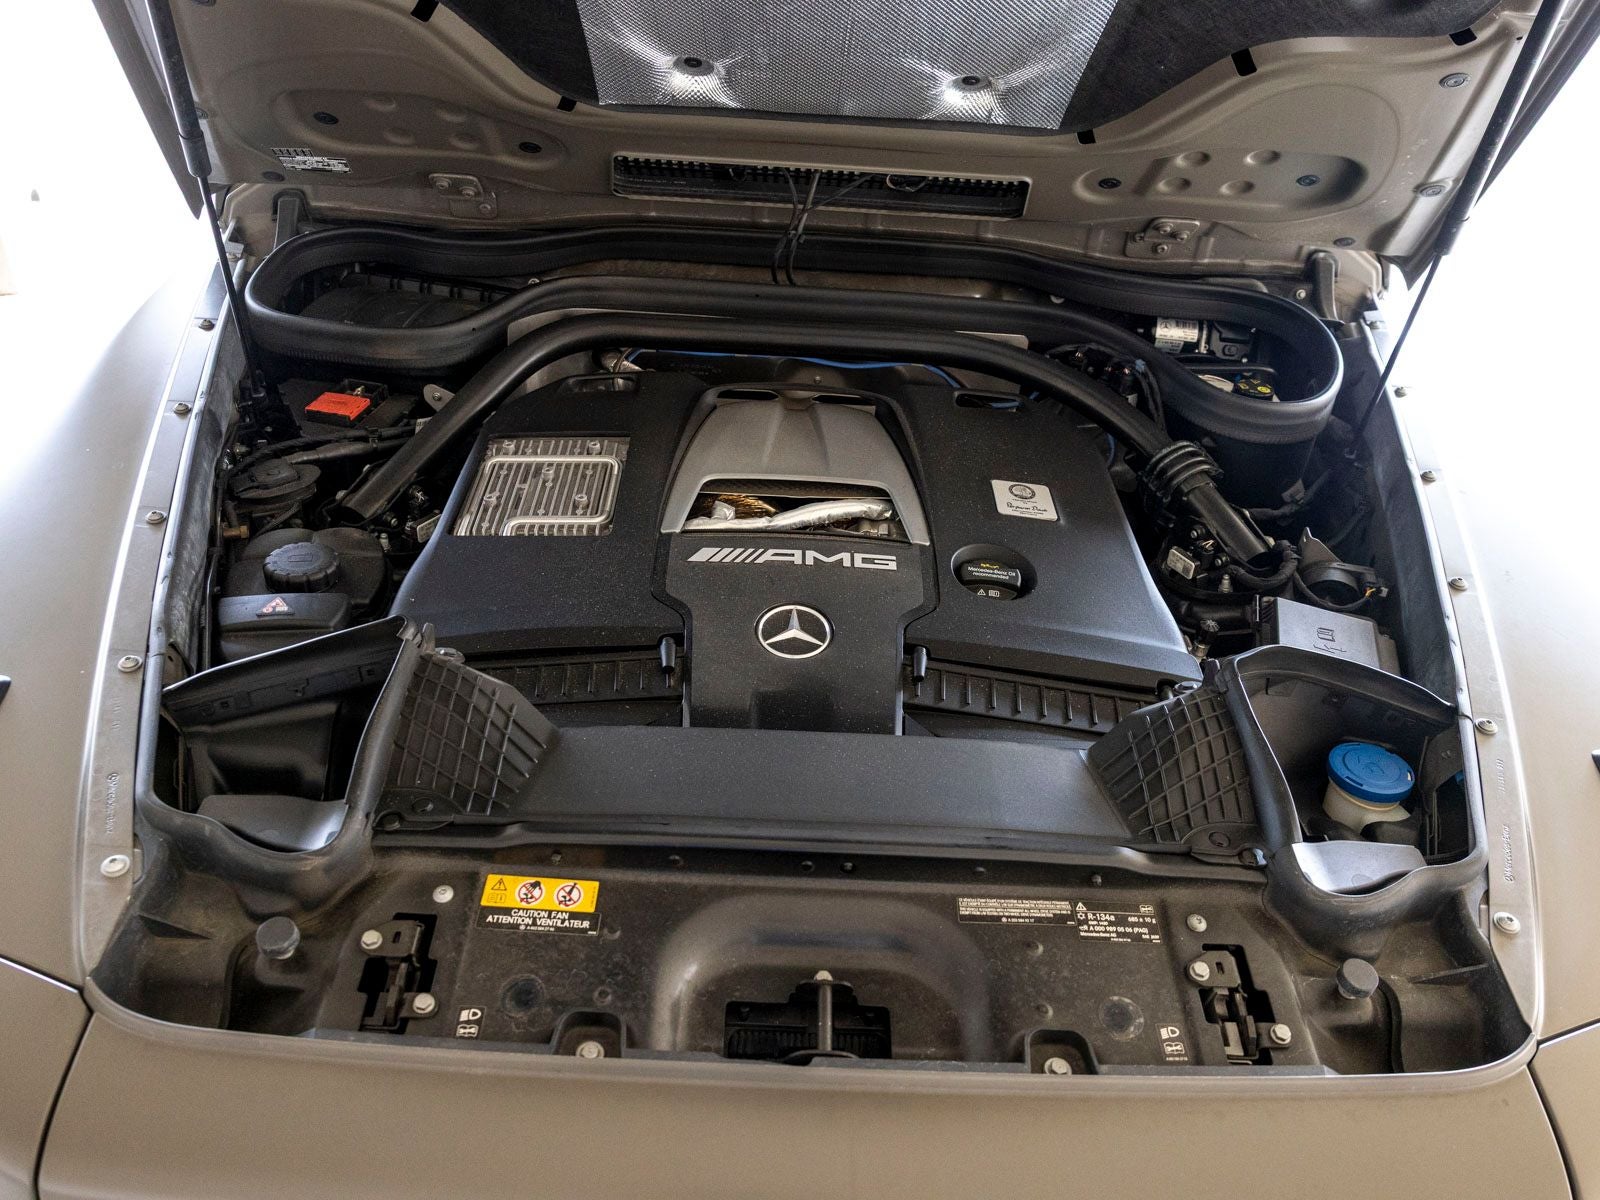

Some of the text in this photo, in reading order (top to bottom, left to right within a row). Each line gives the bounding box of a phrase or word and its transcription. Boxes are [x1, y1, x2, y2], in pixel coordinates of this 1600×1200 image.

[753, 548, 897, 571] AMG
[511, 909, 569, 919] CAUTION FAN
[1087, 912, 1115, 921] R-134a
[486, 915, 533, 926] ATTENTION
[536, 918, 590, 929] VENTILATEUR
